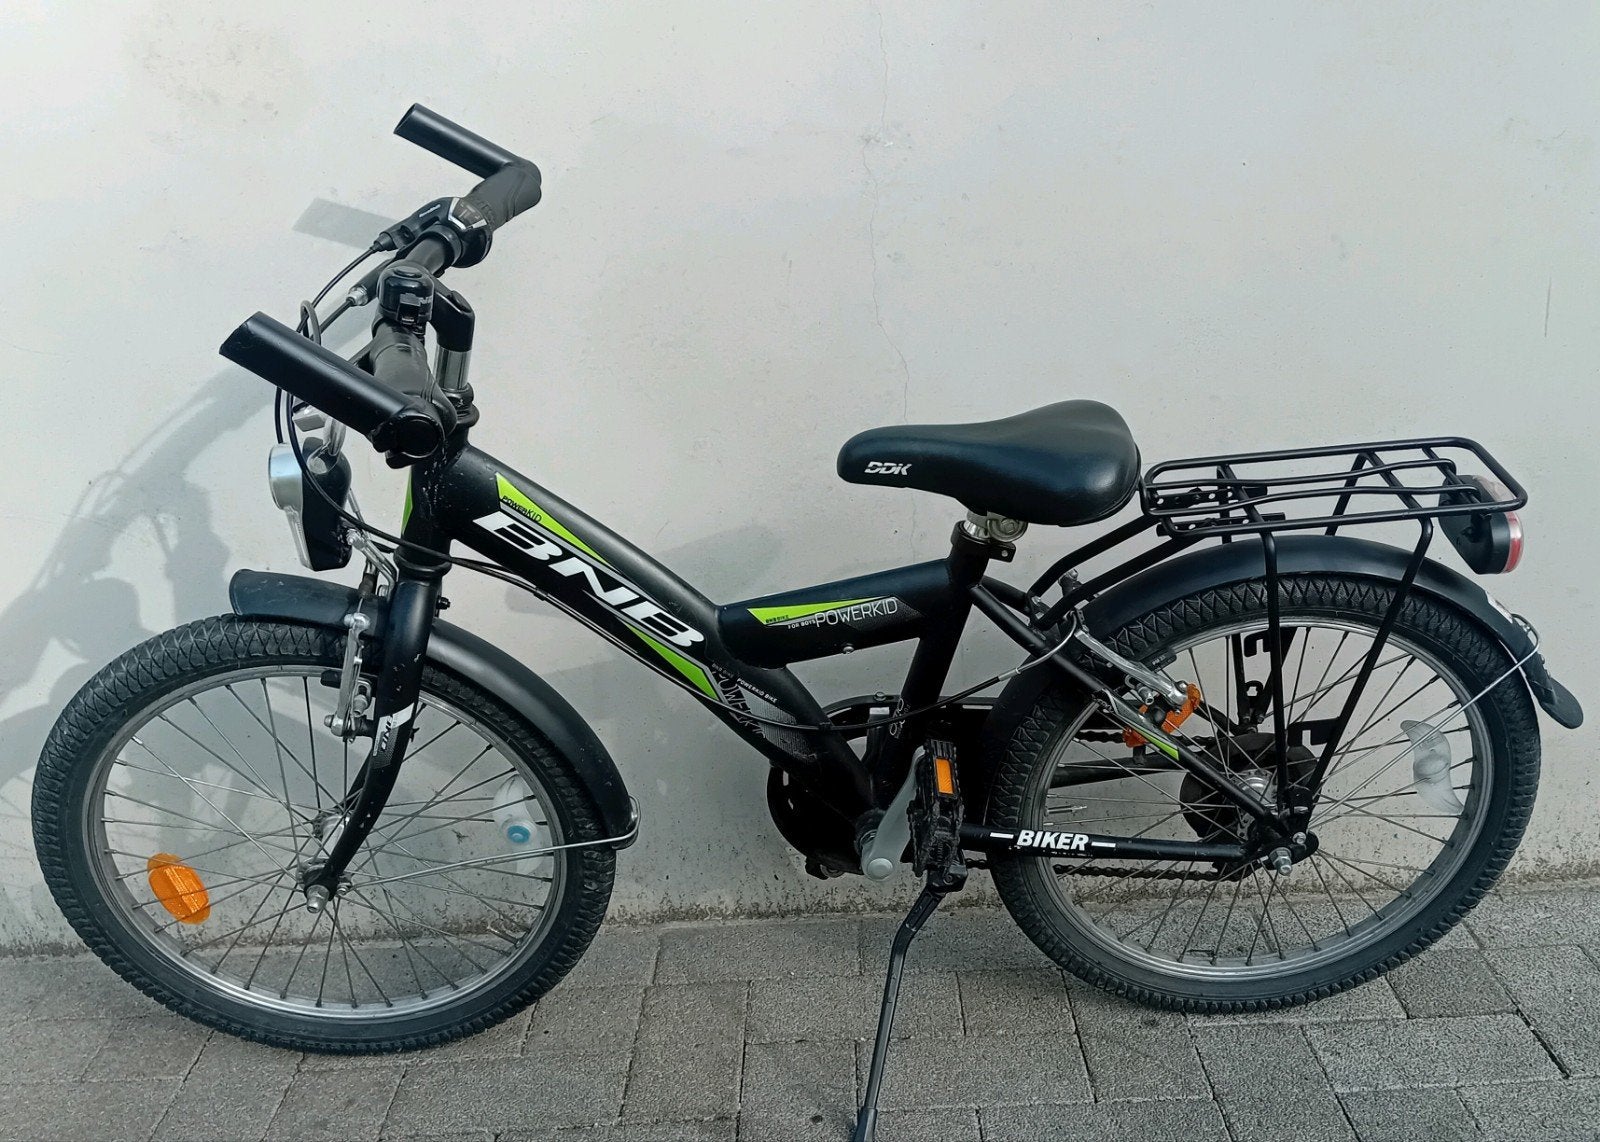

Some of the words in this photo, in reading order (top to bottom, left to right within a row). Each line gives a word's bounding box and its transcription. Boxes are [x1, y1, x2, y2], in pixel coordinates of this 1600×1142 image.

[864, 461, 912, 476] DDK
[501, 495, 543, 522] POWERKID
[472, 510, 705, 647] BNB
[814, 598, 898, 628] POWERKID
[1016, 829, 1089, 851] BIKER
